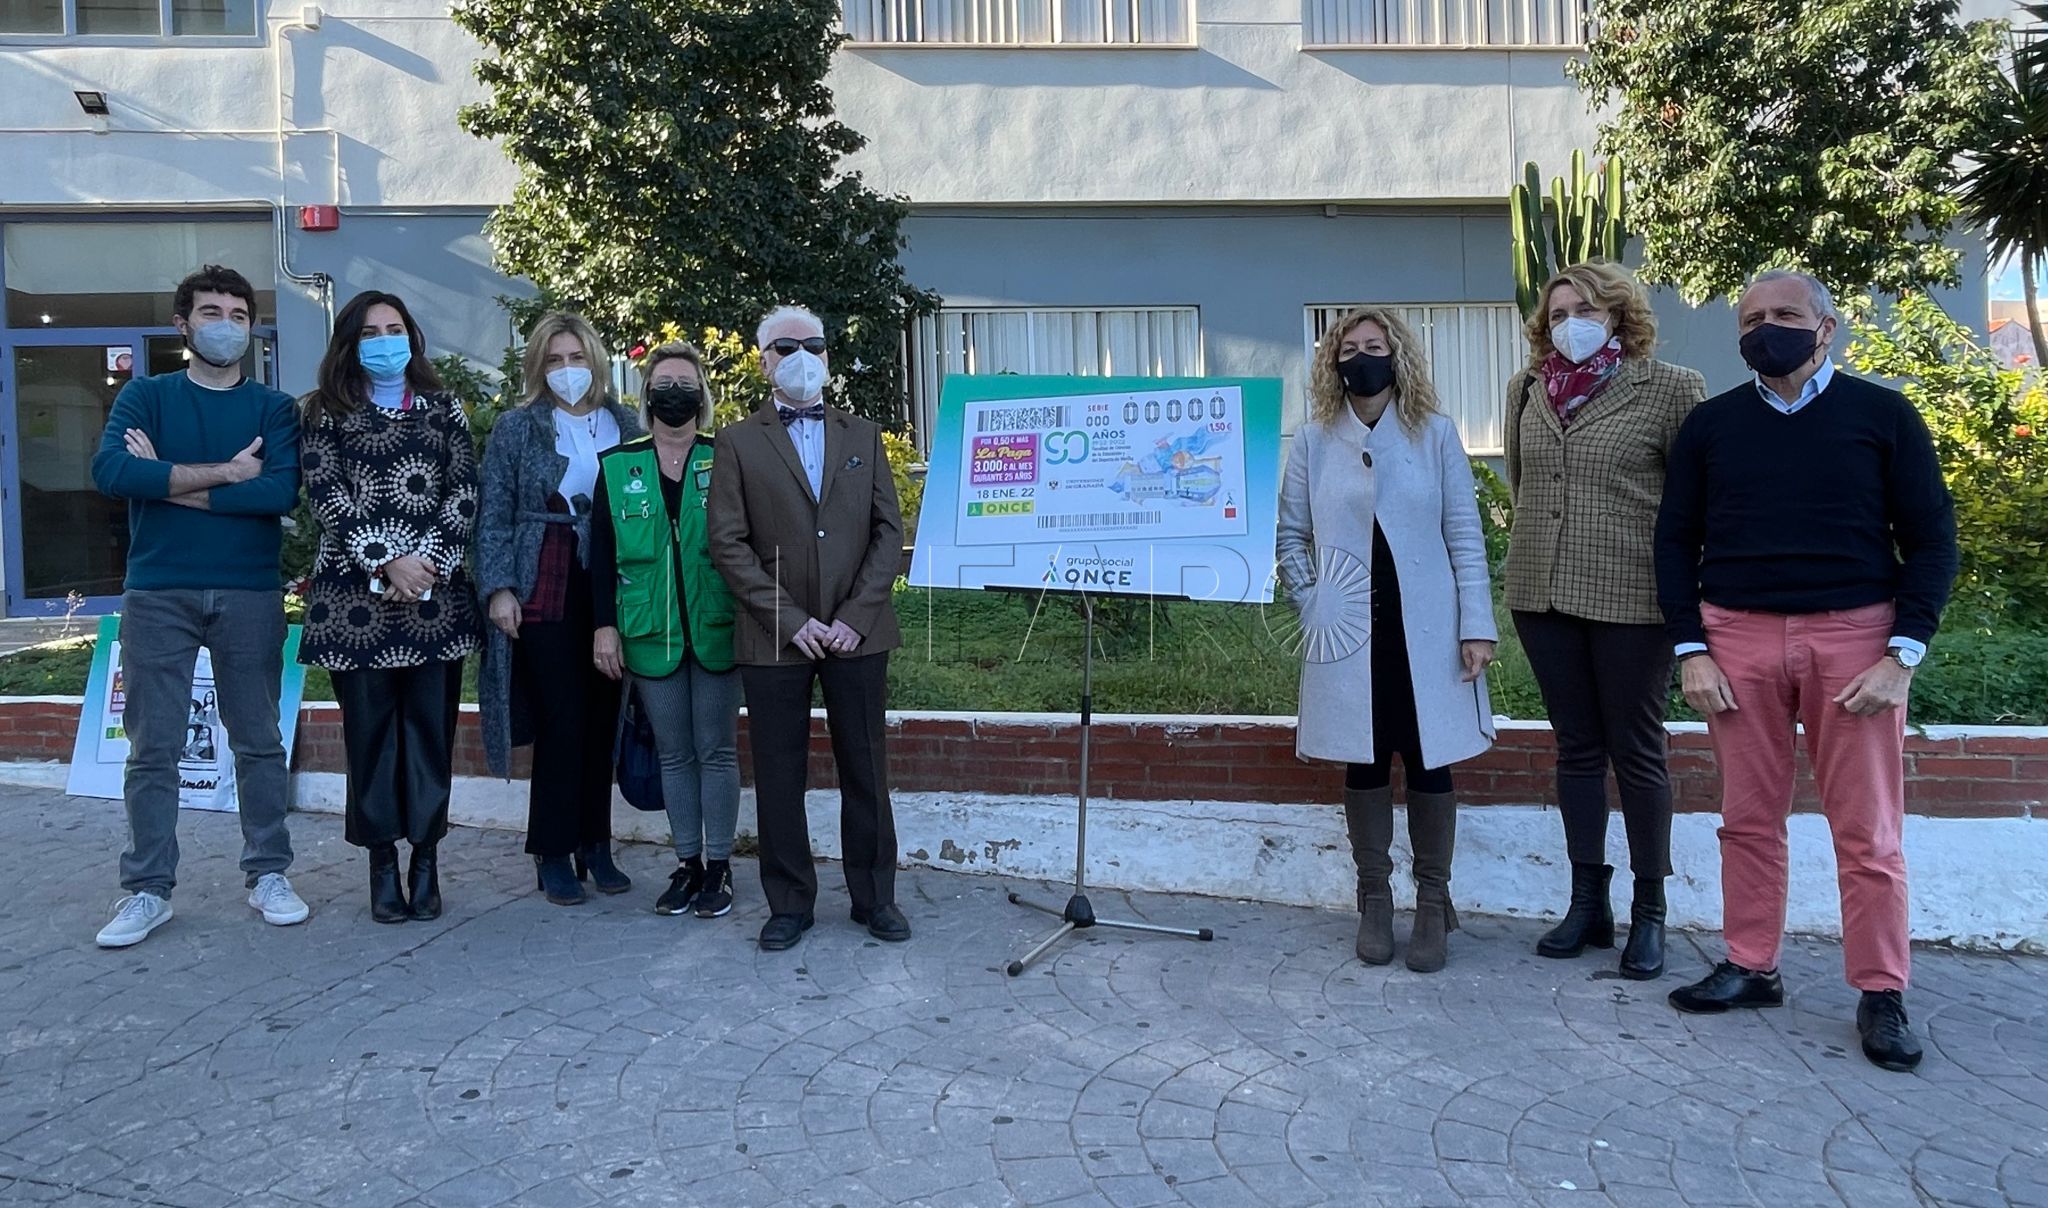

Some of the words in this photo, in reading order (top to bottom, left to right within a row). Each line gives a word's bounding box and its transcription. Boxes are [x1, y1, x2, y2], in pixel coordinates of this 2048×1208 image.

[1087, 404, 1109, 412] SERIE
[1086, 415, 1110, 427] 000
[1092, 429, 1126, 439] AÑOS
[974, 447, 997, 459] La
[997, 446, 1033, 460] Paga
[974, 460, 1003, 473] 3.000
[1009, 463, 1018, 471] AL
[1018, 462, 1033, 470] MES
[973, 473, 1003, 483] DURANTE
[1004, 472, 1013, 481] 25
[1014, 471, 1033, 481] AÑOS
[977, 490, 990, 499] 18
[992, 488, 1018, 498] ENE.
[1021, 487, 1035, 497] 22
[986, 502, 1031, 514] ONCE
[1066, 557, 1099, 567] grupo
[1102, 557, 1134, 567] social
[1064, 568, 1132, 586] ONCE
